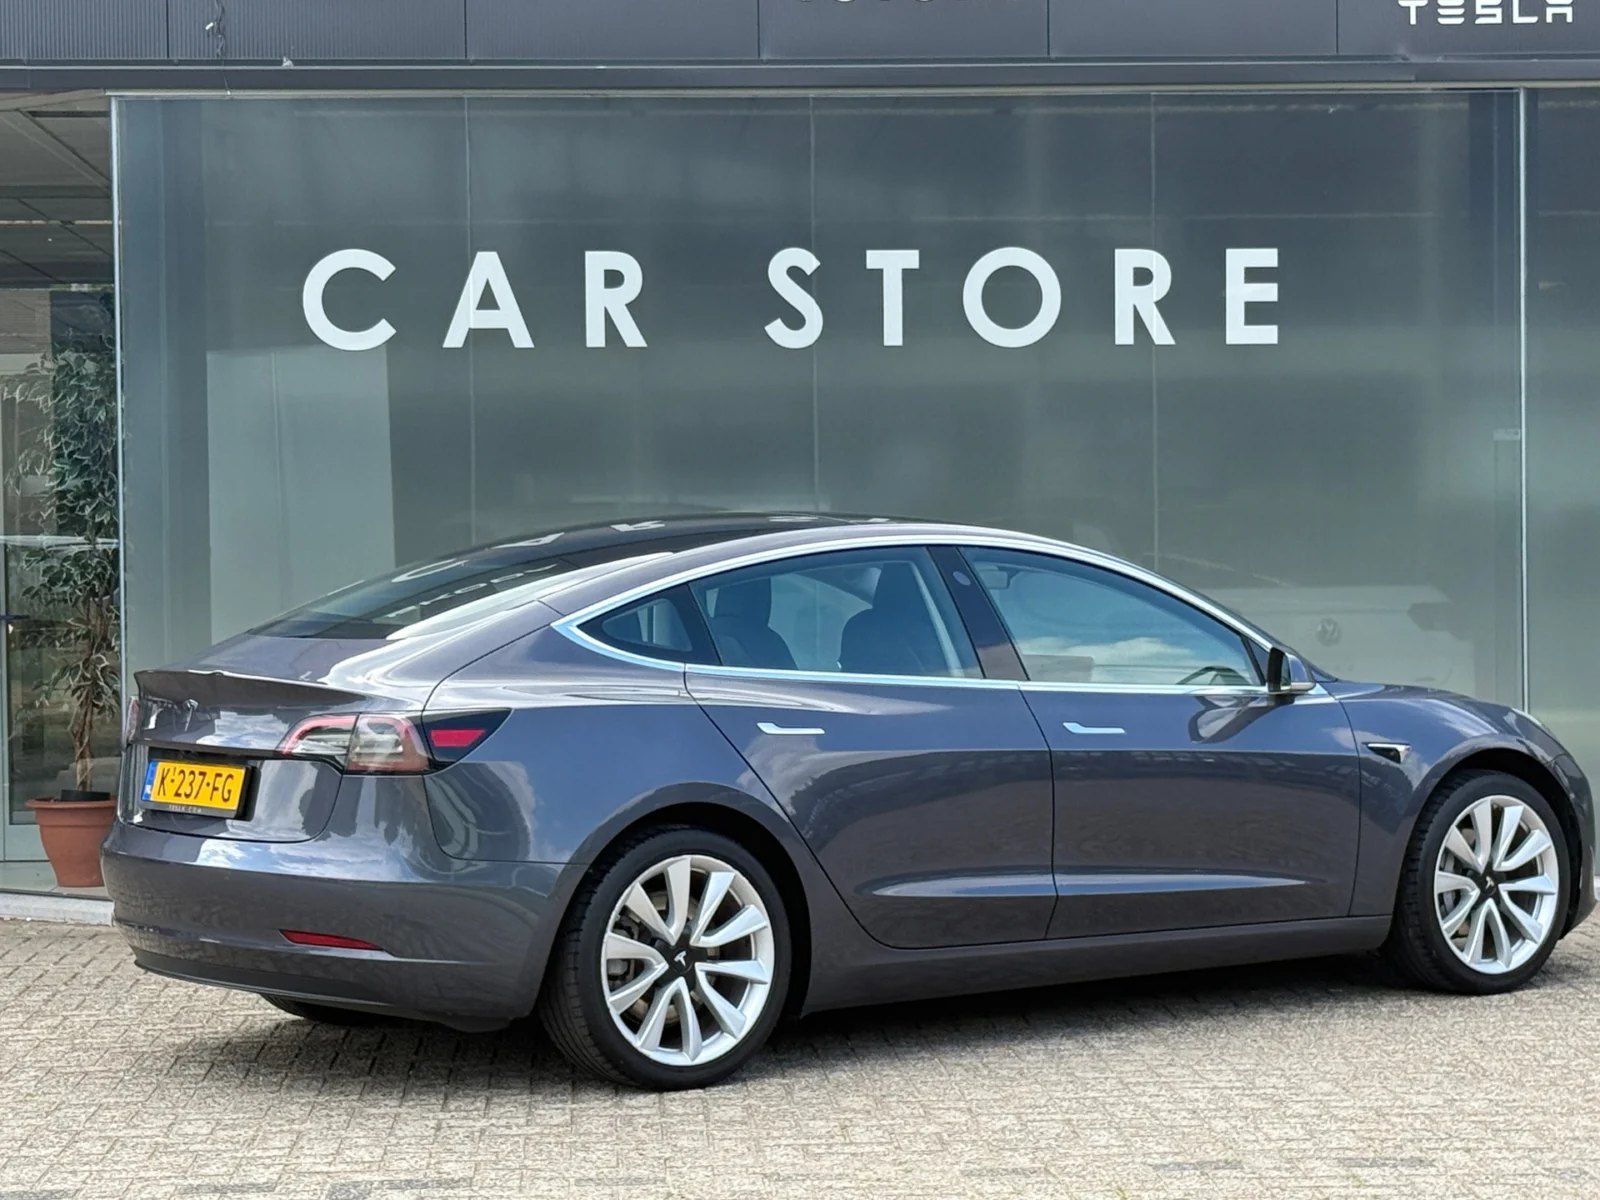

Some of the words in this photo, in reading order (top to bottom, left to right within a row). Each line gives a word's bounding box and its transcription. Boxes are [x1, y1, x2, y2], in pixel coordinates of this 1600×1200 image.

[1398, 0, 1573, 25] TESLA
[302, 248, 648, 351] CAR
[764, 246, 1279, 349] STORE
